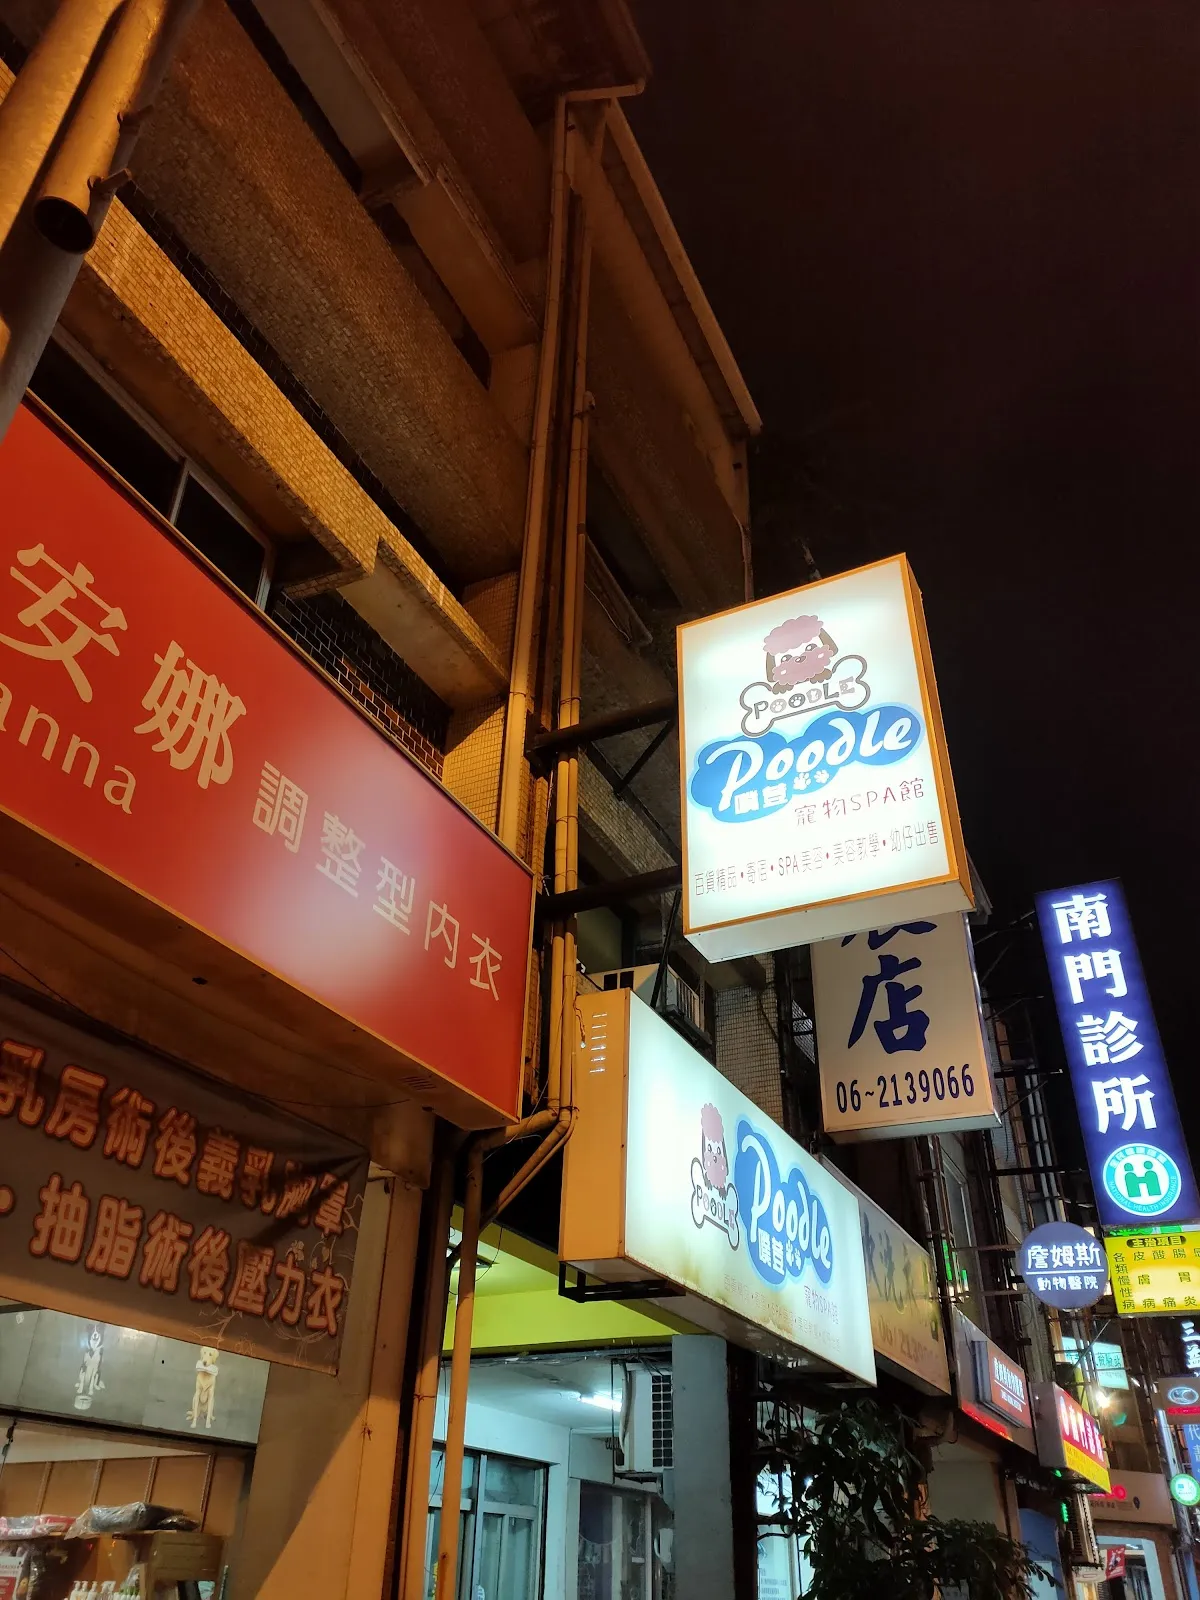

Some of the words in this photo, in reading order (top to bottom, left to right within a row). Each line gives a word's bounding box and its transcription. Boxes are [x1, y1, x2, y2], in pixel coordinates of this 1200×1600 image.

[753, 676, 856, 720] POODLE
[706, 710, 912, 812] Poodle
[1051, 892, 1158, 1135] 南門診所
[696, 1184, 735, 1231] POODLE
[741, 1134, 833, 1270] Poodle
[1027, 1242, 1102, 1270] 詹姆斯
[1037, 1275, 1099, 1291] 動物醫院
